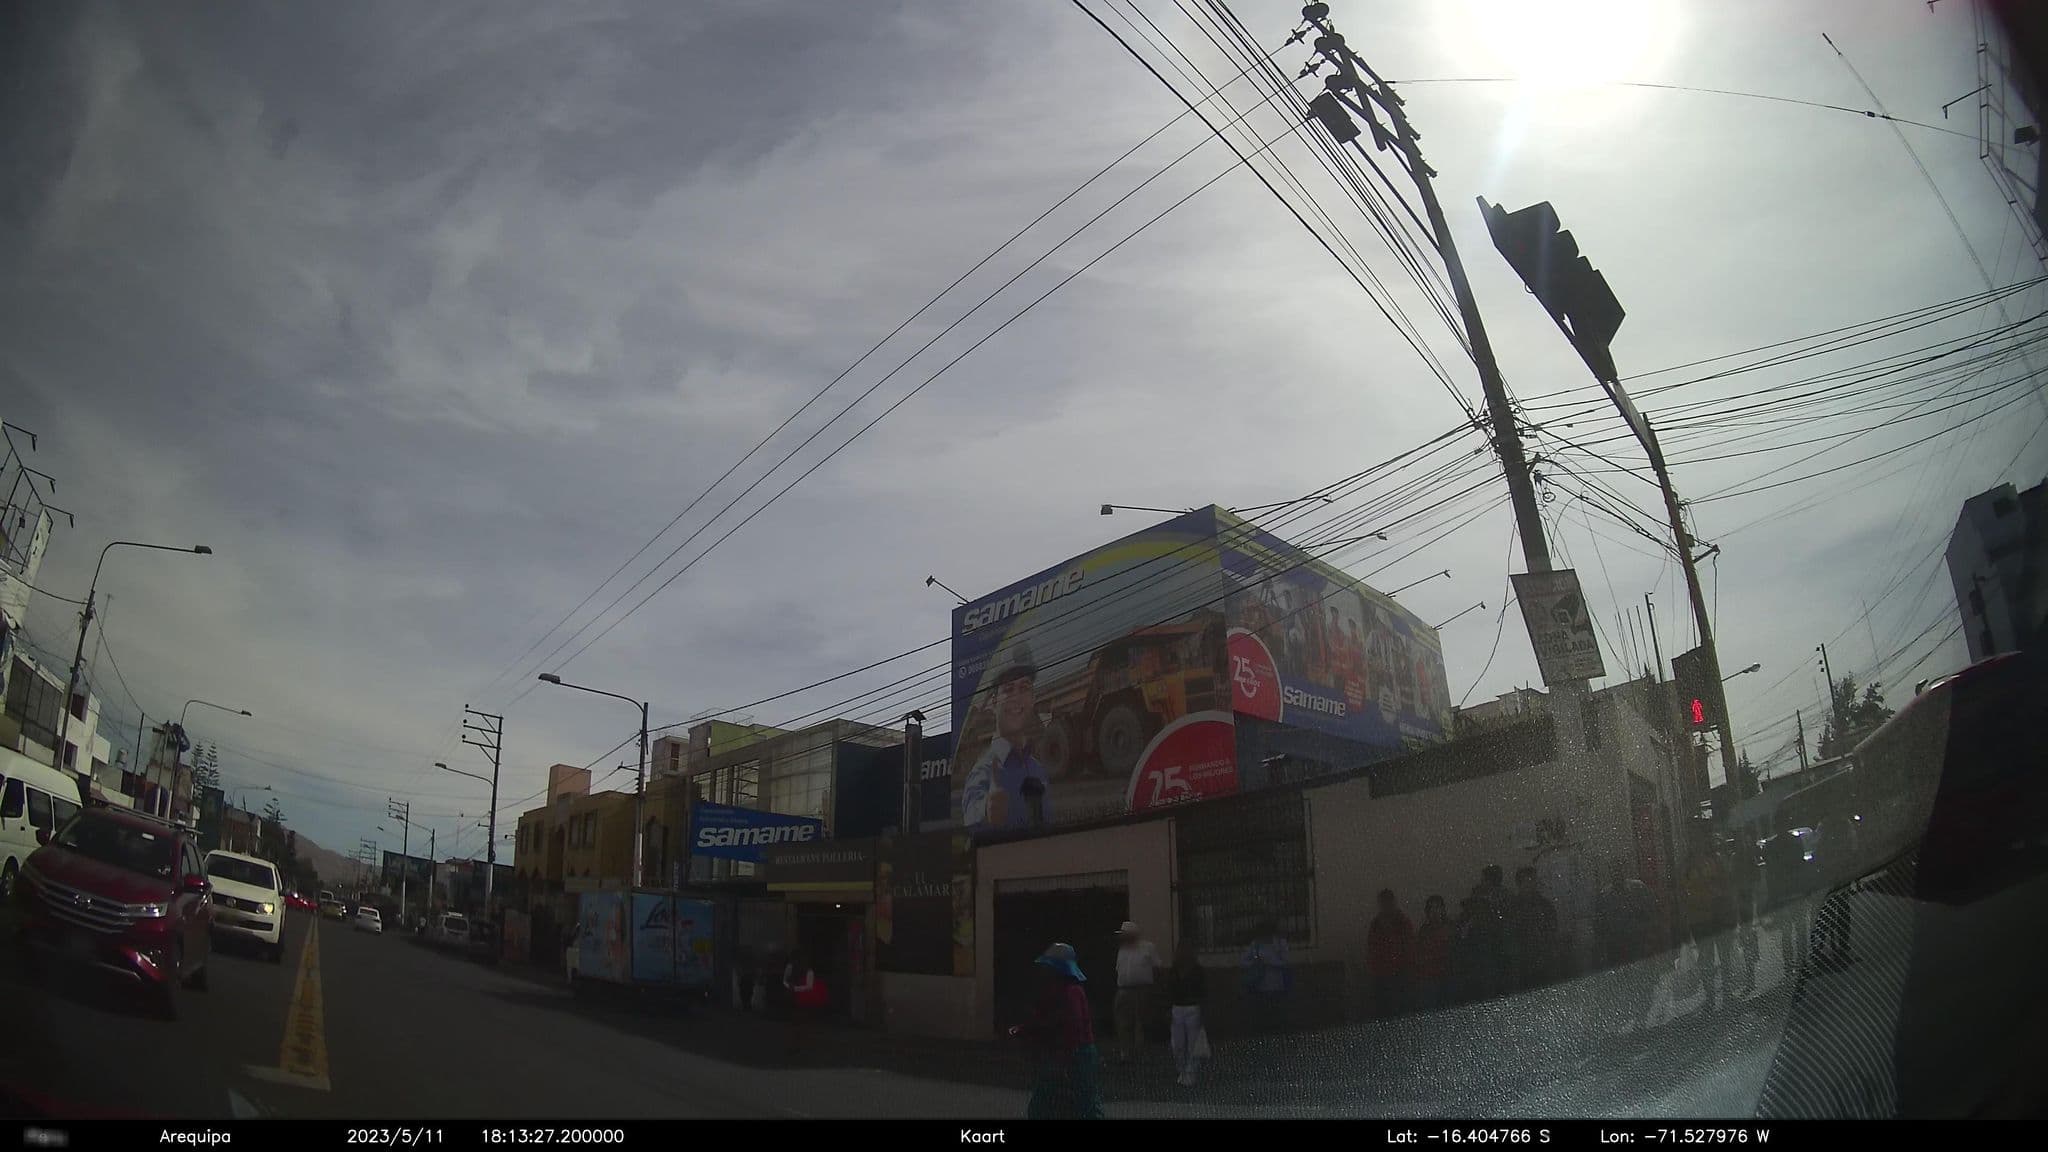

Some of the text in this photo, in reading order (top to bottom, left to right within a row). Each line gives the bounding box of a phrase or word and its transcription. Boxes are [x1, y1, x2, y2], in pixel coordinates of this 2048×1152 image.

[960, 567, 1085, 636] samame
[1283, 685, 1346, 717] samame
[696, 823, 816, 848] samame
